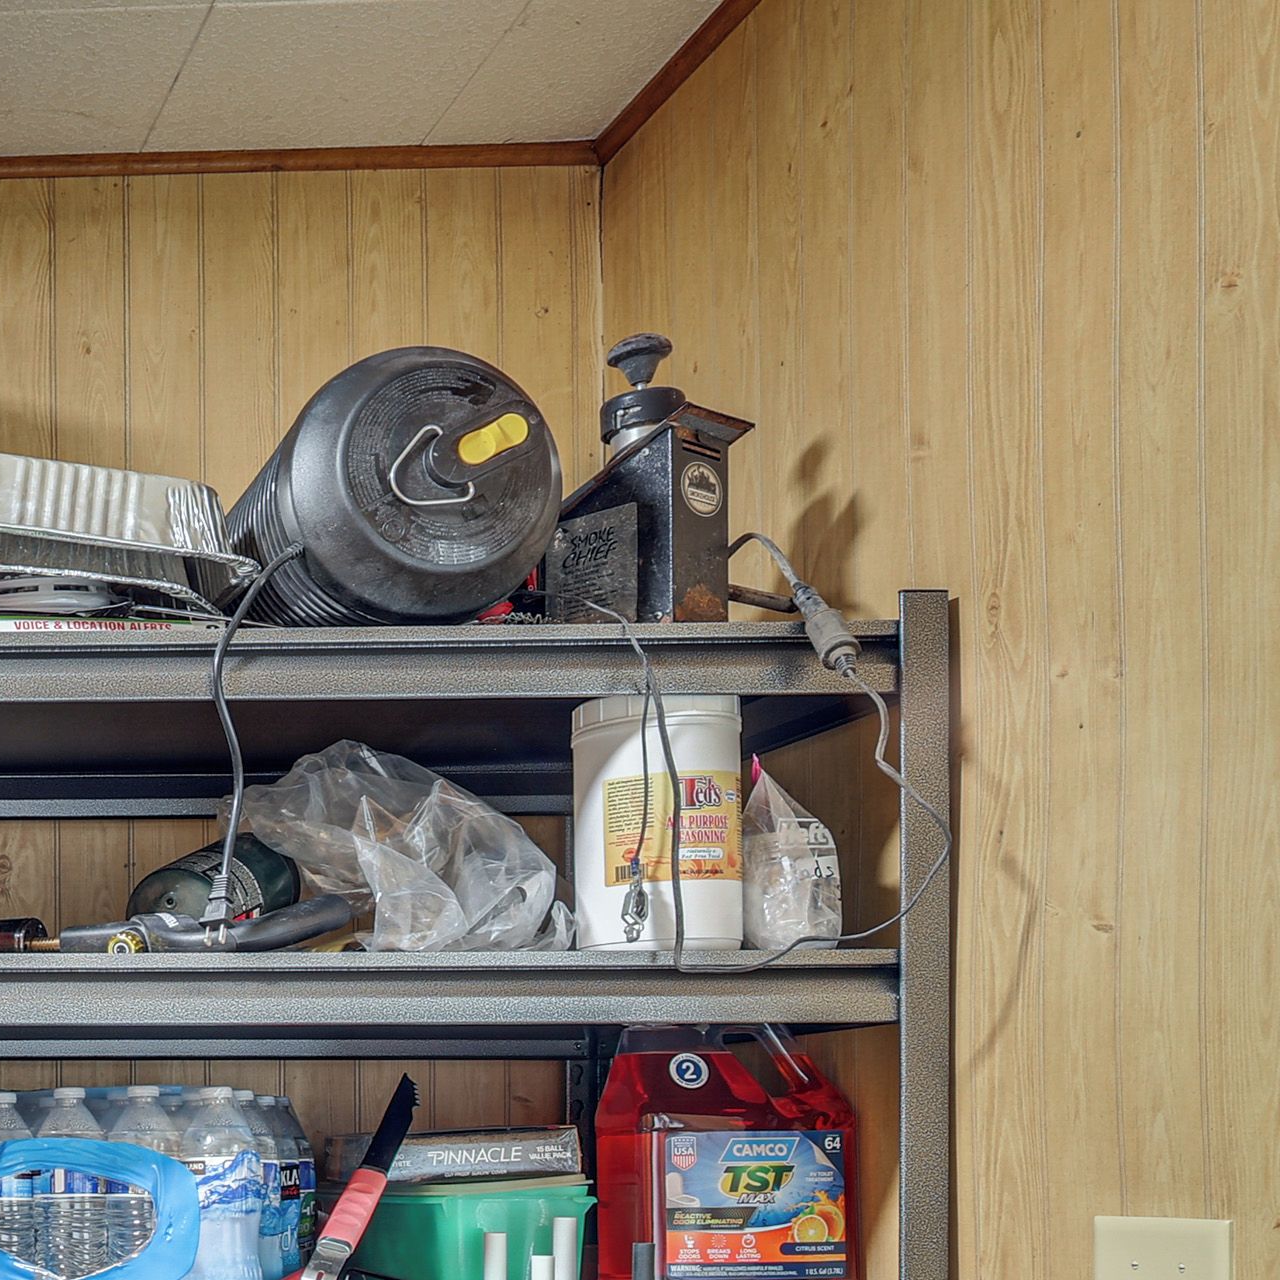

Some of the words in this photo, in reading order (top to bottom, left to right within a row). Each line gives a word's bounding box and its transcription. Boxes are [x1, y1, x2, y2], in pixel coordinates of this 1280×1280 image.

[570, 526, 615, 551] SMOKE
[562, 540, 618, 568] CHIEF
[14, 620, 50, 630] VOICE
[54, 620, 63, 630] &
[67, 620, 125, 631] LOCATION
[678, 775, 722, 810] Ted's
[688, 815, 728, 829] PURPOSE
[680, 830, 726, 844] EASONING
[682, 1062, 697, 1080] 2
[732, 1144, 788, 1157] CAMCO
[824, 1137, 841, 1150] 64
[427, 1146, 522, 1166] PINNACLE
[528, 1152, 551, 1160] VALUE
[724, 1165, 795, 1192] TST
[738, 1193, 776, 1204] MAX
